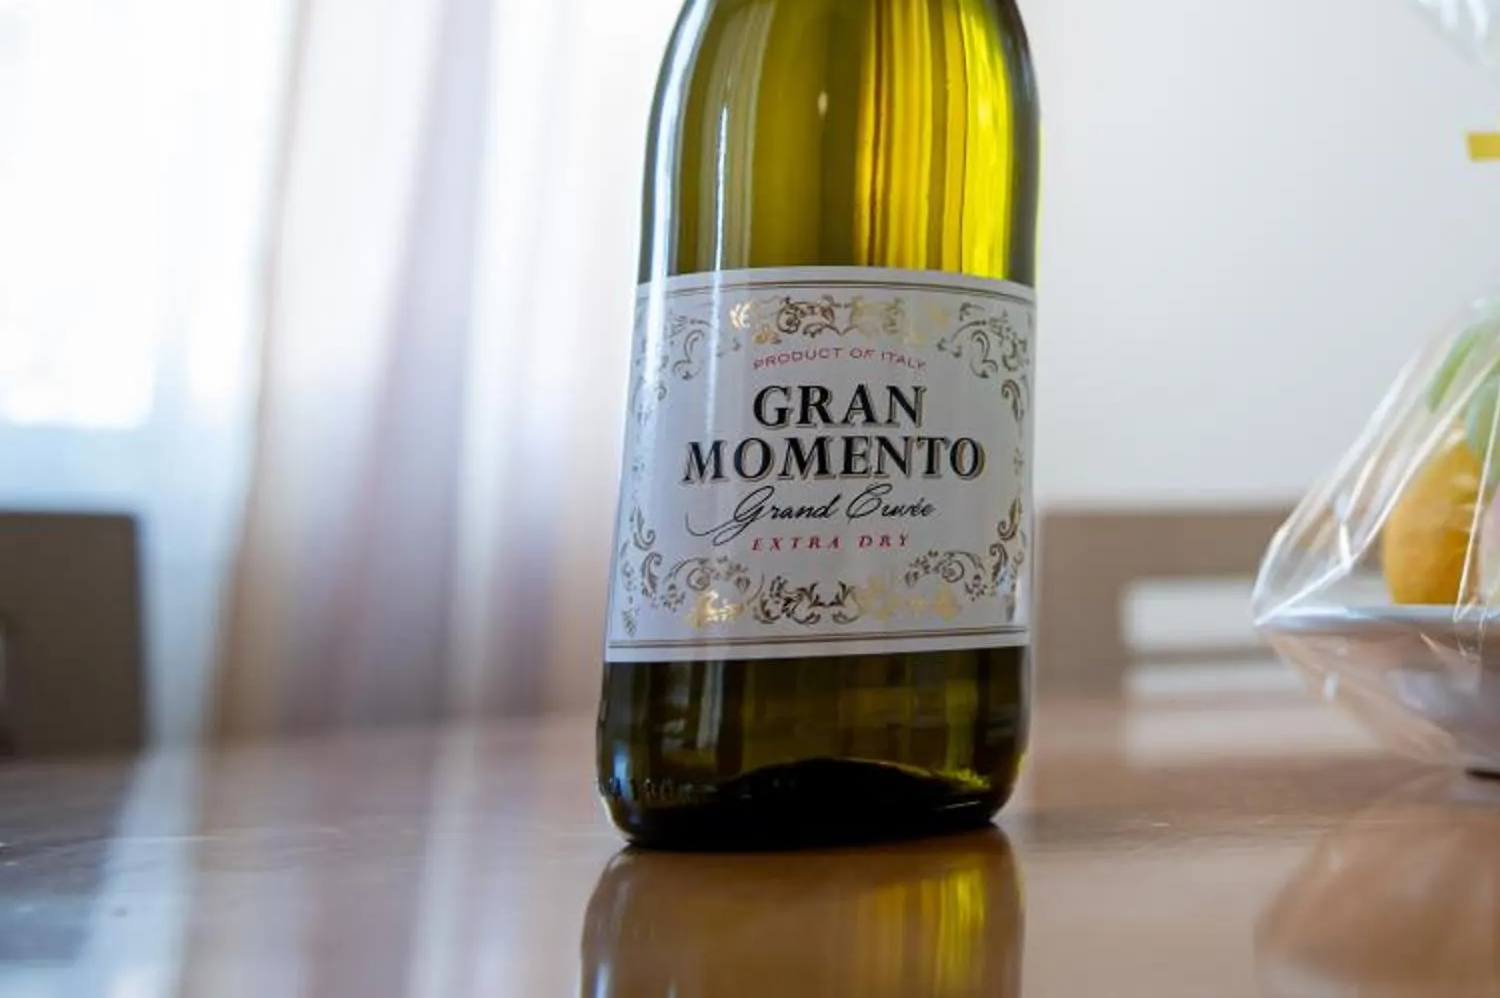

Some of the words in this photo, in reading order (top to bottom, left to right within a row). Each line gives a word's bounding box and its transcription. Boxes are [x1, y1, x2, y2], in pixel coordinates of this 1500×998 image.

[753, 347, 842, 370] PRODUCT
[850, 347, 876, 359] OF
[881, 352, 926, 369] ITALY
[753, 384, 927, 428] GRAN
[681, 436, 986, 484] MOMENTO
[685, 485, 841, 546] Grand
[846, 483, 936, 523] Cuvée
[751, 536, 841, 551] EXTRA
[859, 535, 910, 549] DRY
